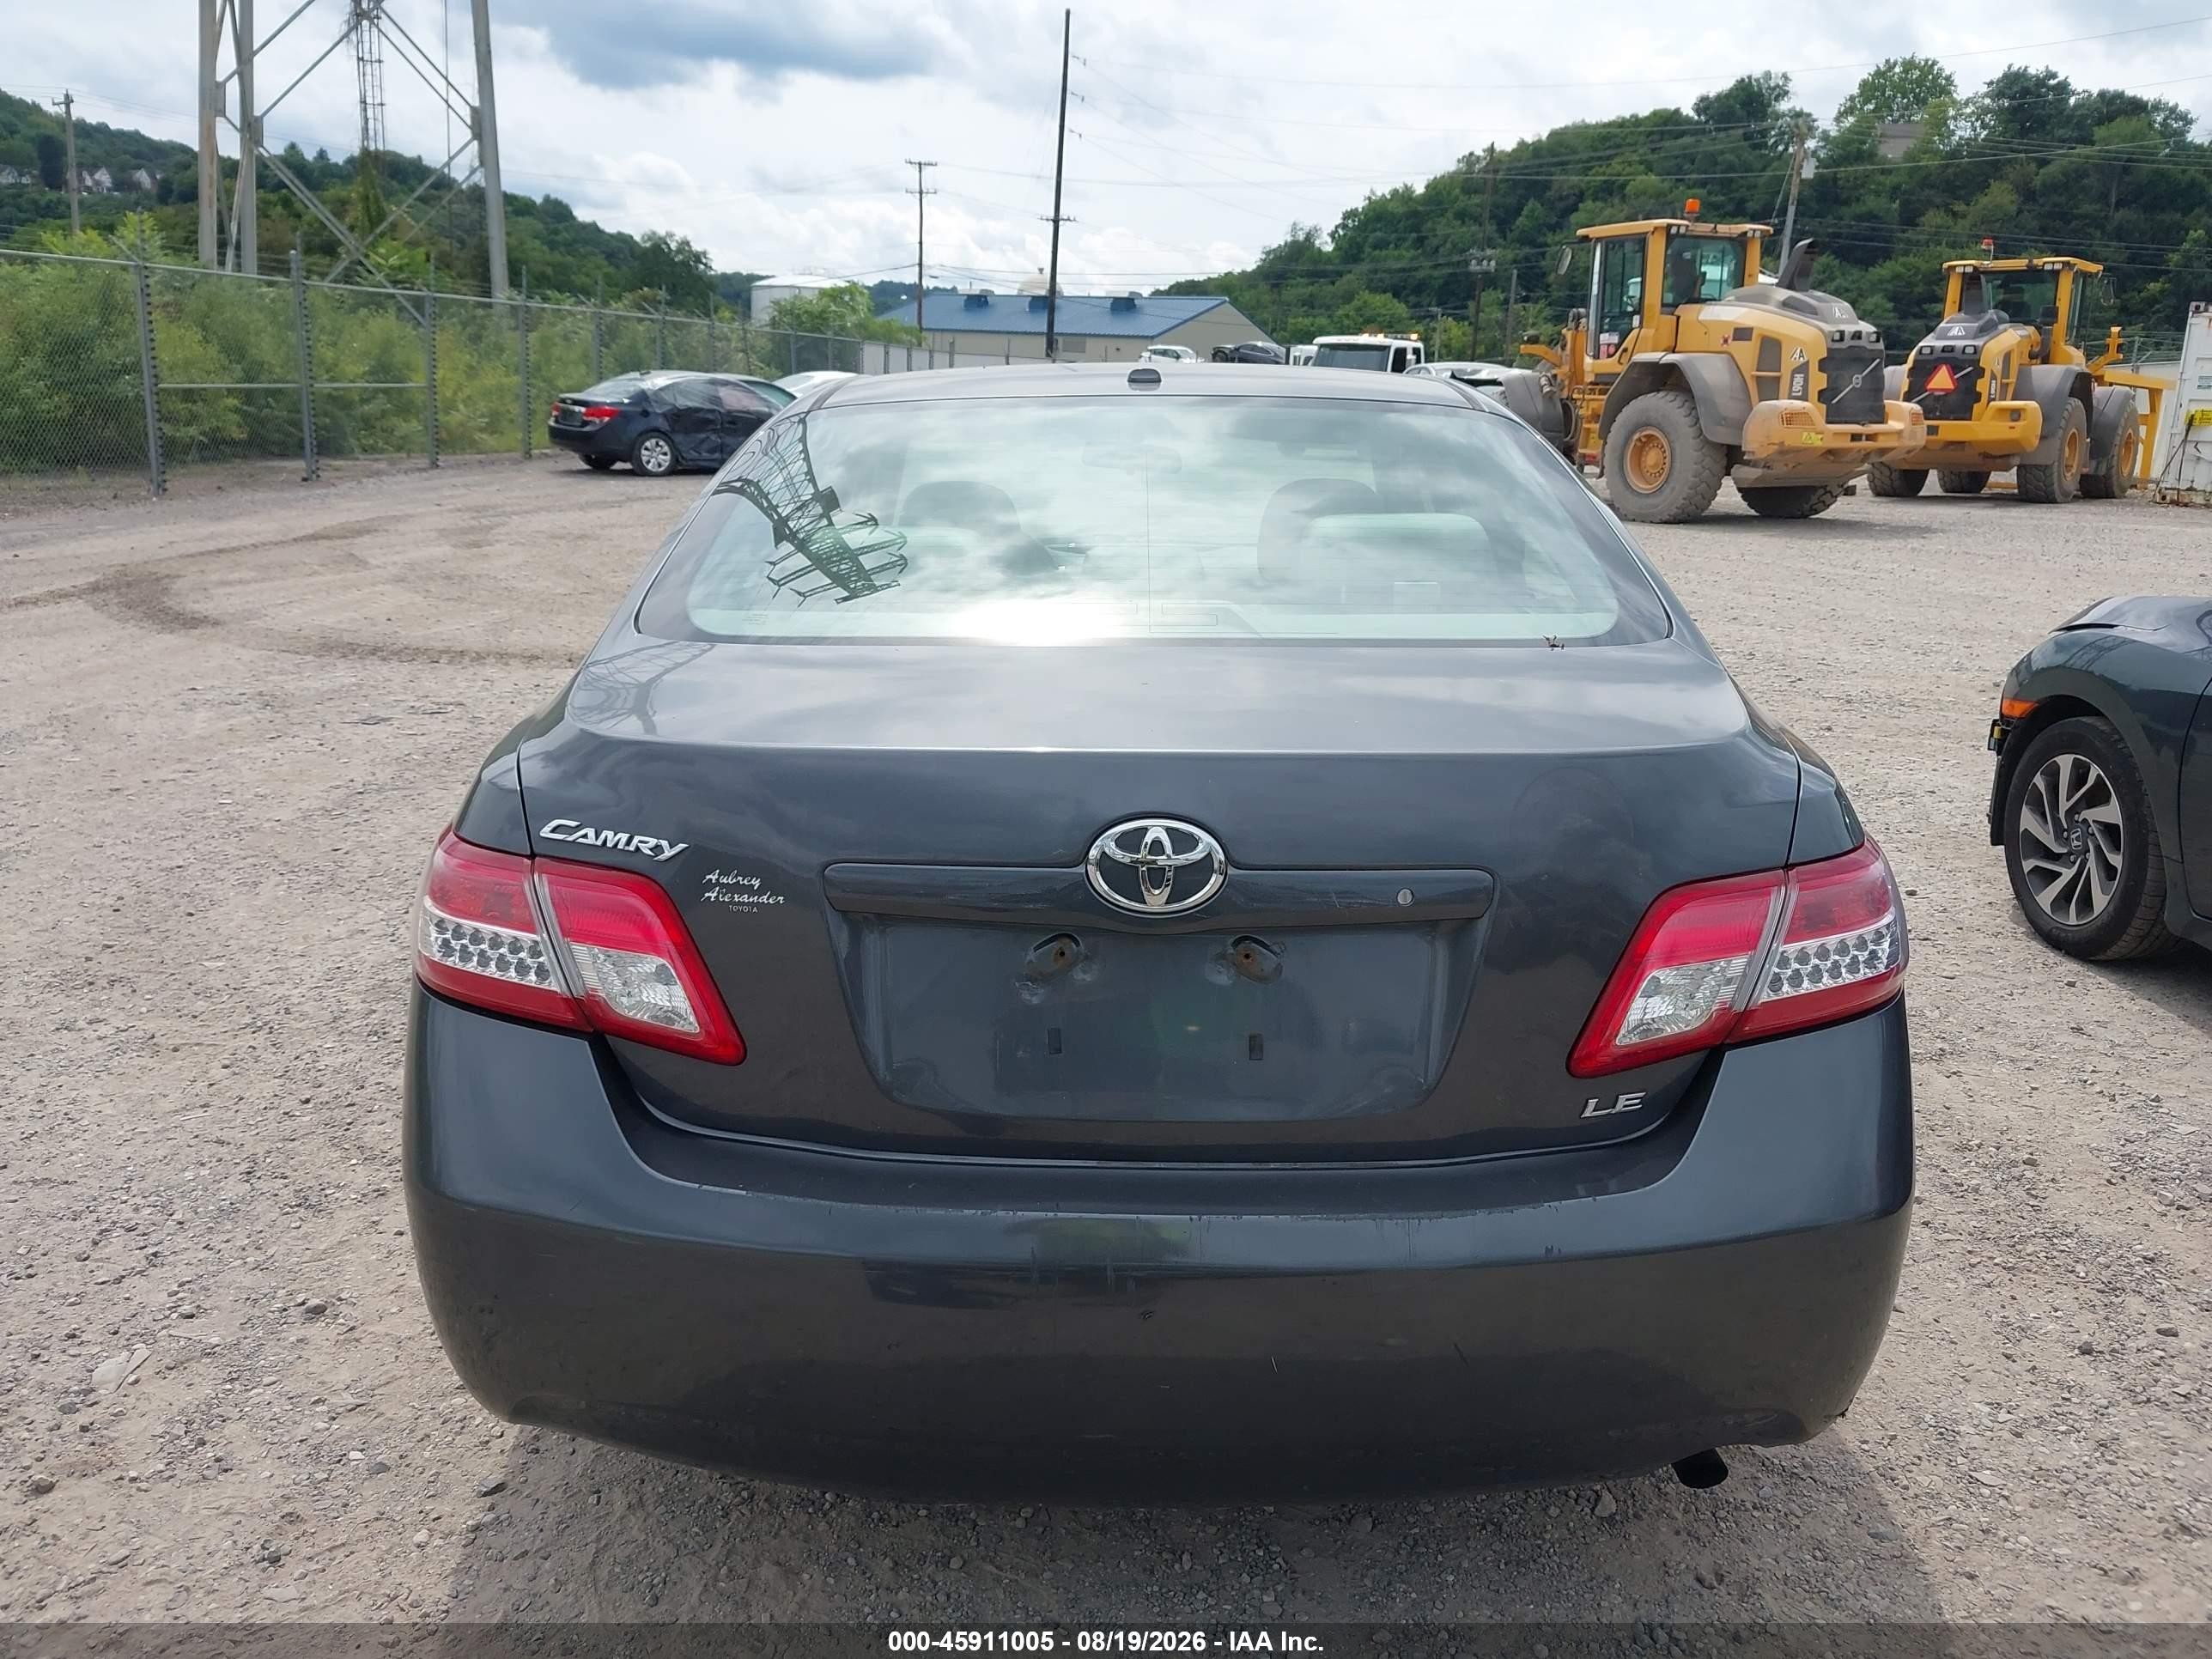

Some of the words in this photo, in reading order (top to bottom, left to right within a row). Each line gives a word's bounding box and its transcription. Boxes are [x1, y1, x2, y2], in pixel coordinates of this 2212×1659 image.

[1791, 374, 1805, 396] L90H
[539, 819, 690, 861] CAMRY
[702, 869, 762, 890] Aubrey
[701, 887, 785, 904] Alexander
[1581, 1091, 1646, 1118] LE
